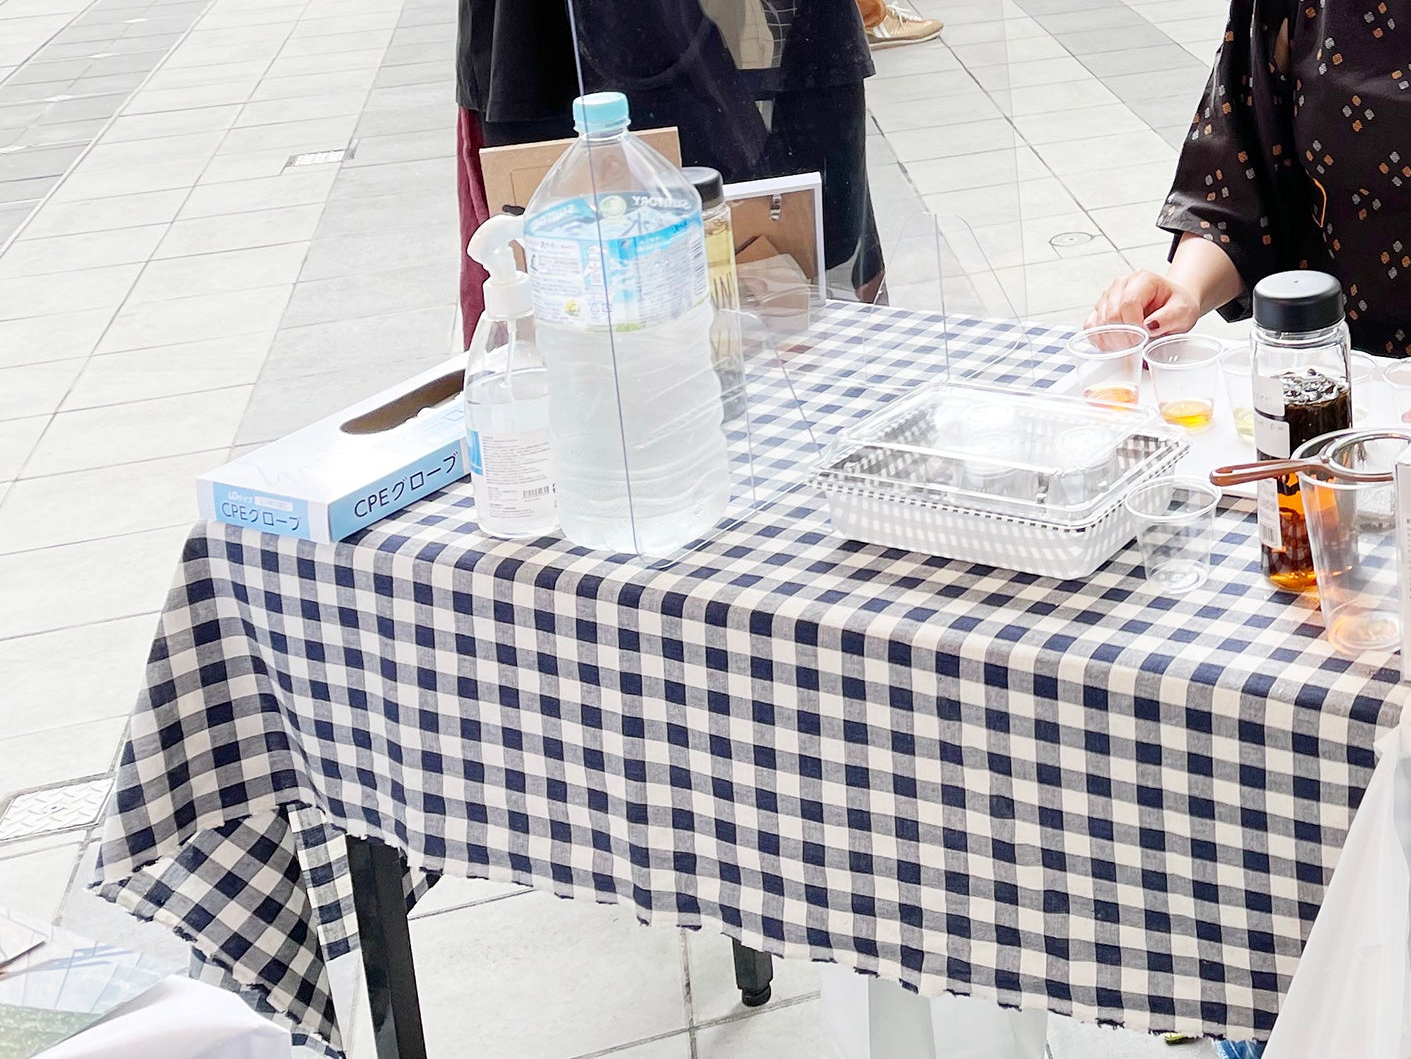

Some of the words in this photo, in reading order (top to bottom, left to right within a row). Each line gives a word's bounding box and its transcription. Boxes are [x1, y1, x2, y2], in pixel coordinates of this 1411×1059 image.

[353, 450, 460, 518] CPEグローブ
[221, 502, 302, 531] CPEグローブ
